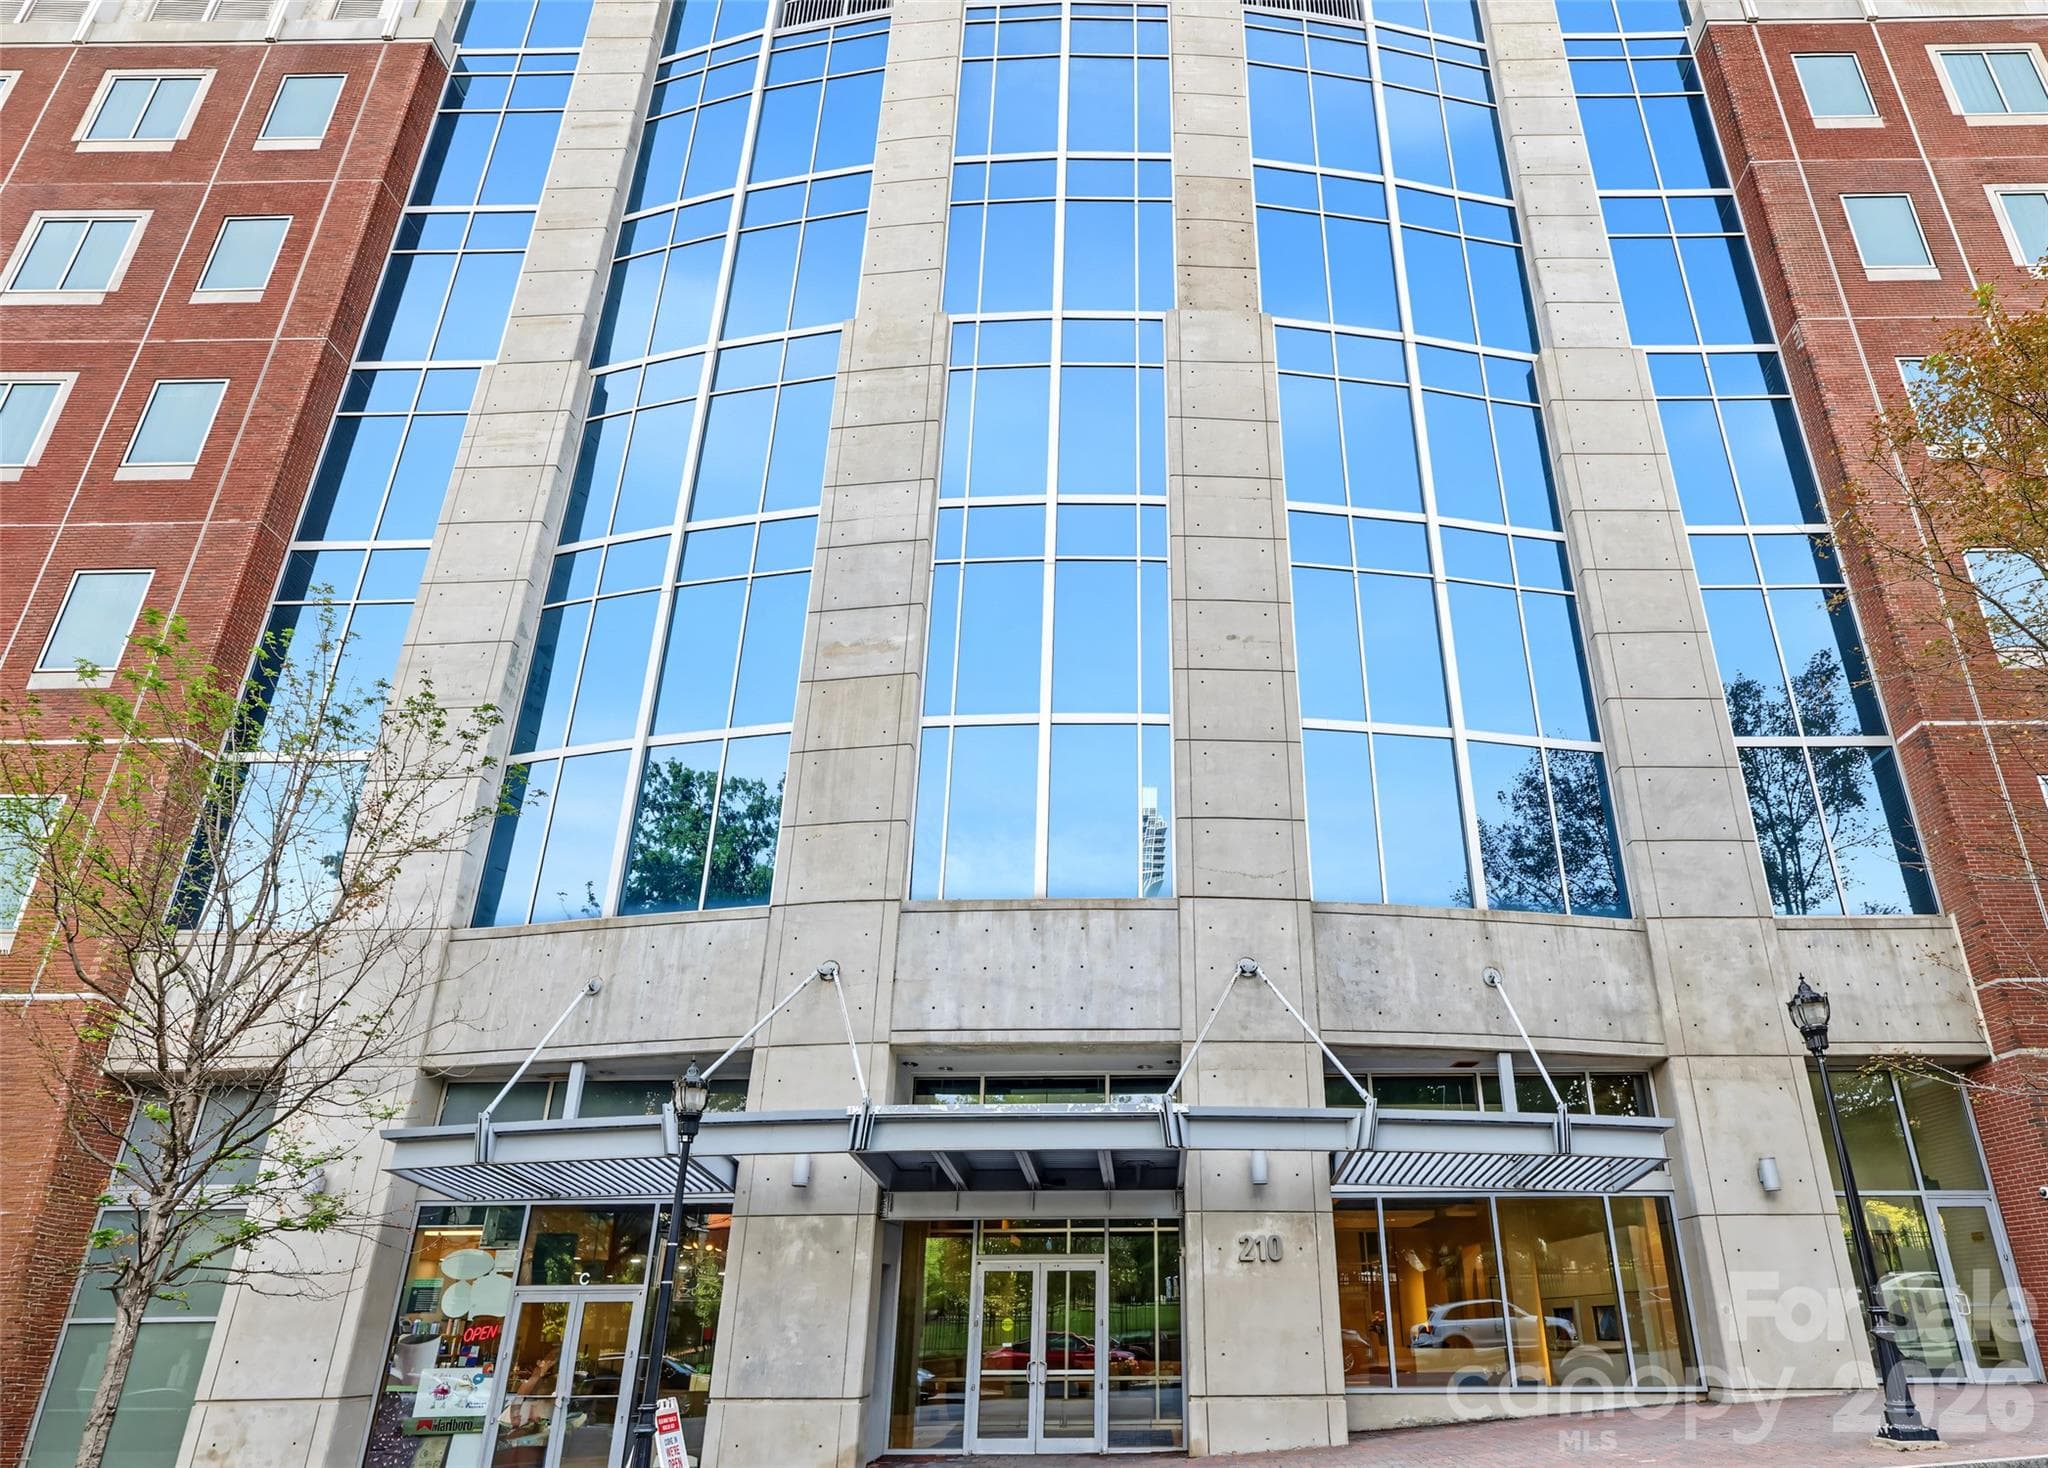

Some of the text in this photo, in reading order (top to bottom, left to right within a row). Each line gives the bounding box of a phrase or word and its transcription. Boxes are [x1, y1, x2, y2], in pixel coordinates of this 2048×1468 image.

[1238, 1234, 1283, 1262] 210
[579, 1272, 591, 1286] C
[463, 1324, 499, 1343] OPEN
[431, 1418, 473, 1432] Marlboro
